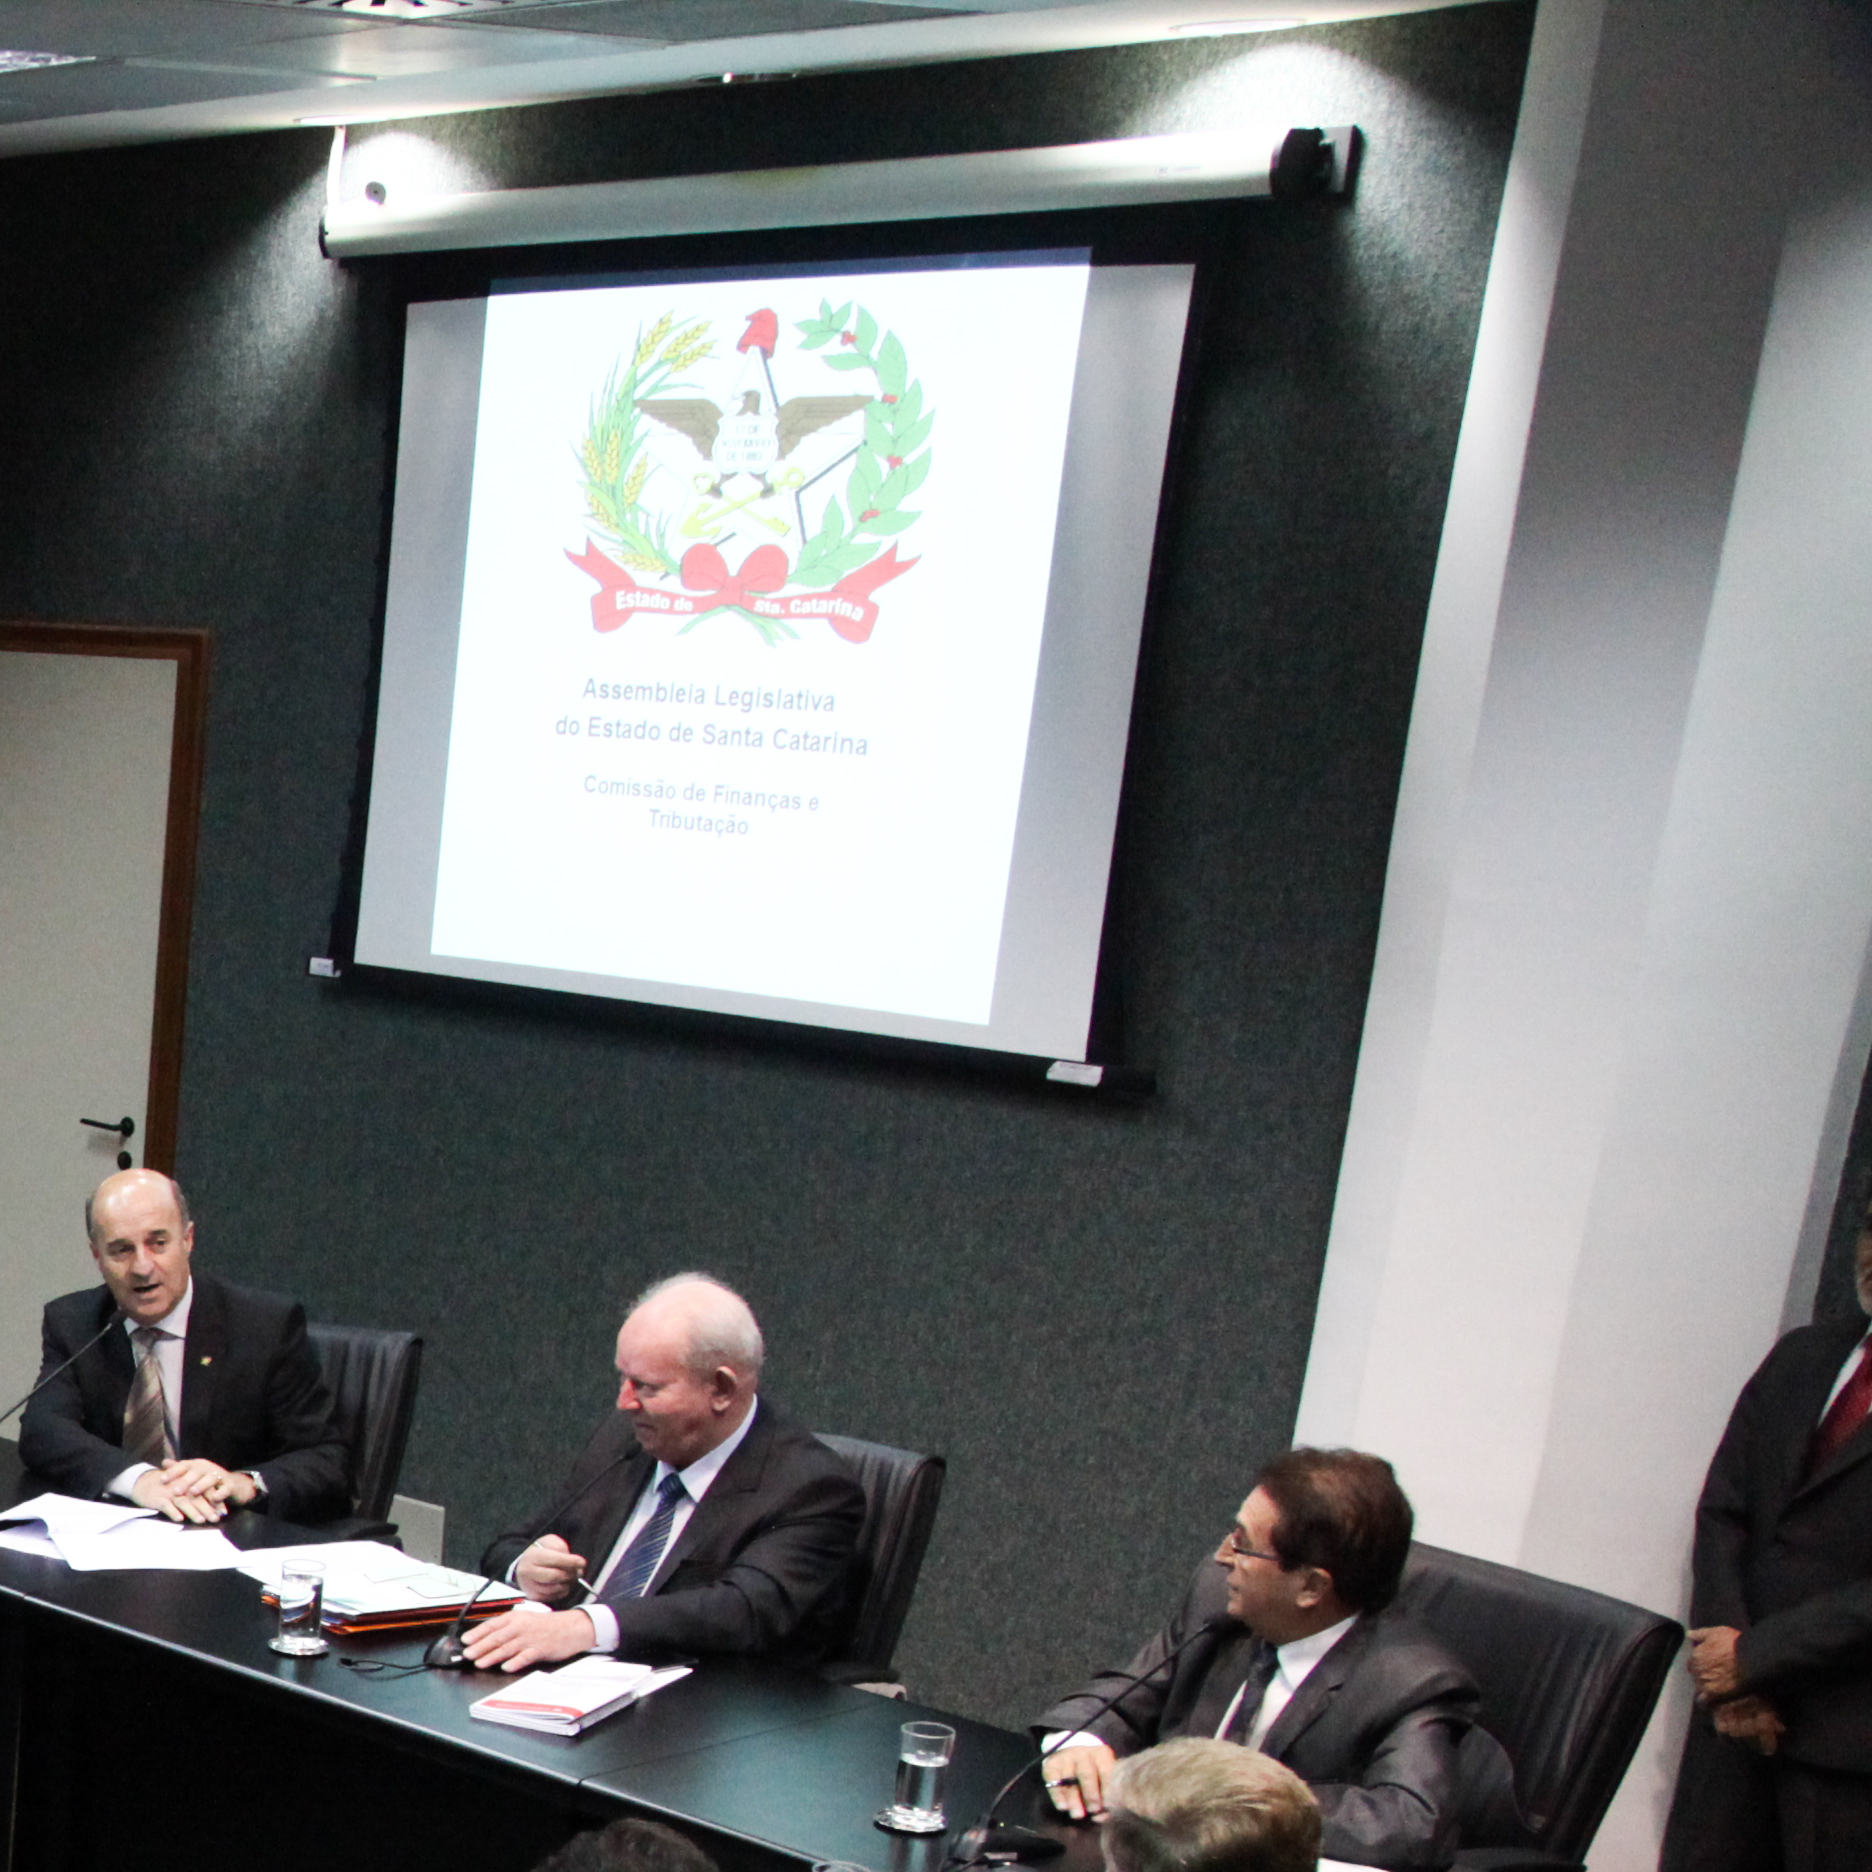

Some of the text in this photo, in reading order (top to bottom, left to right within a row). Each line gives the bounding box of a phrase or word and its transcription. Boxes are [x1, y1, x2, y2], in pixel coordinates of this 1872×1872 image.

[616, 590, 671, 610] Estado
[753, 598, 865, 621] Sta. Catarina
[583, 678, 835, 713] Assembleia Legislativa
[555, 715, 869, 756] do Estado de Santa Catarina
[583, 774, 819, 813] Comissão de Finanças e
[649, 808, 749, 838] Tributação
